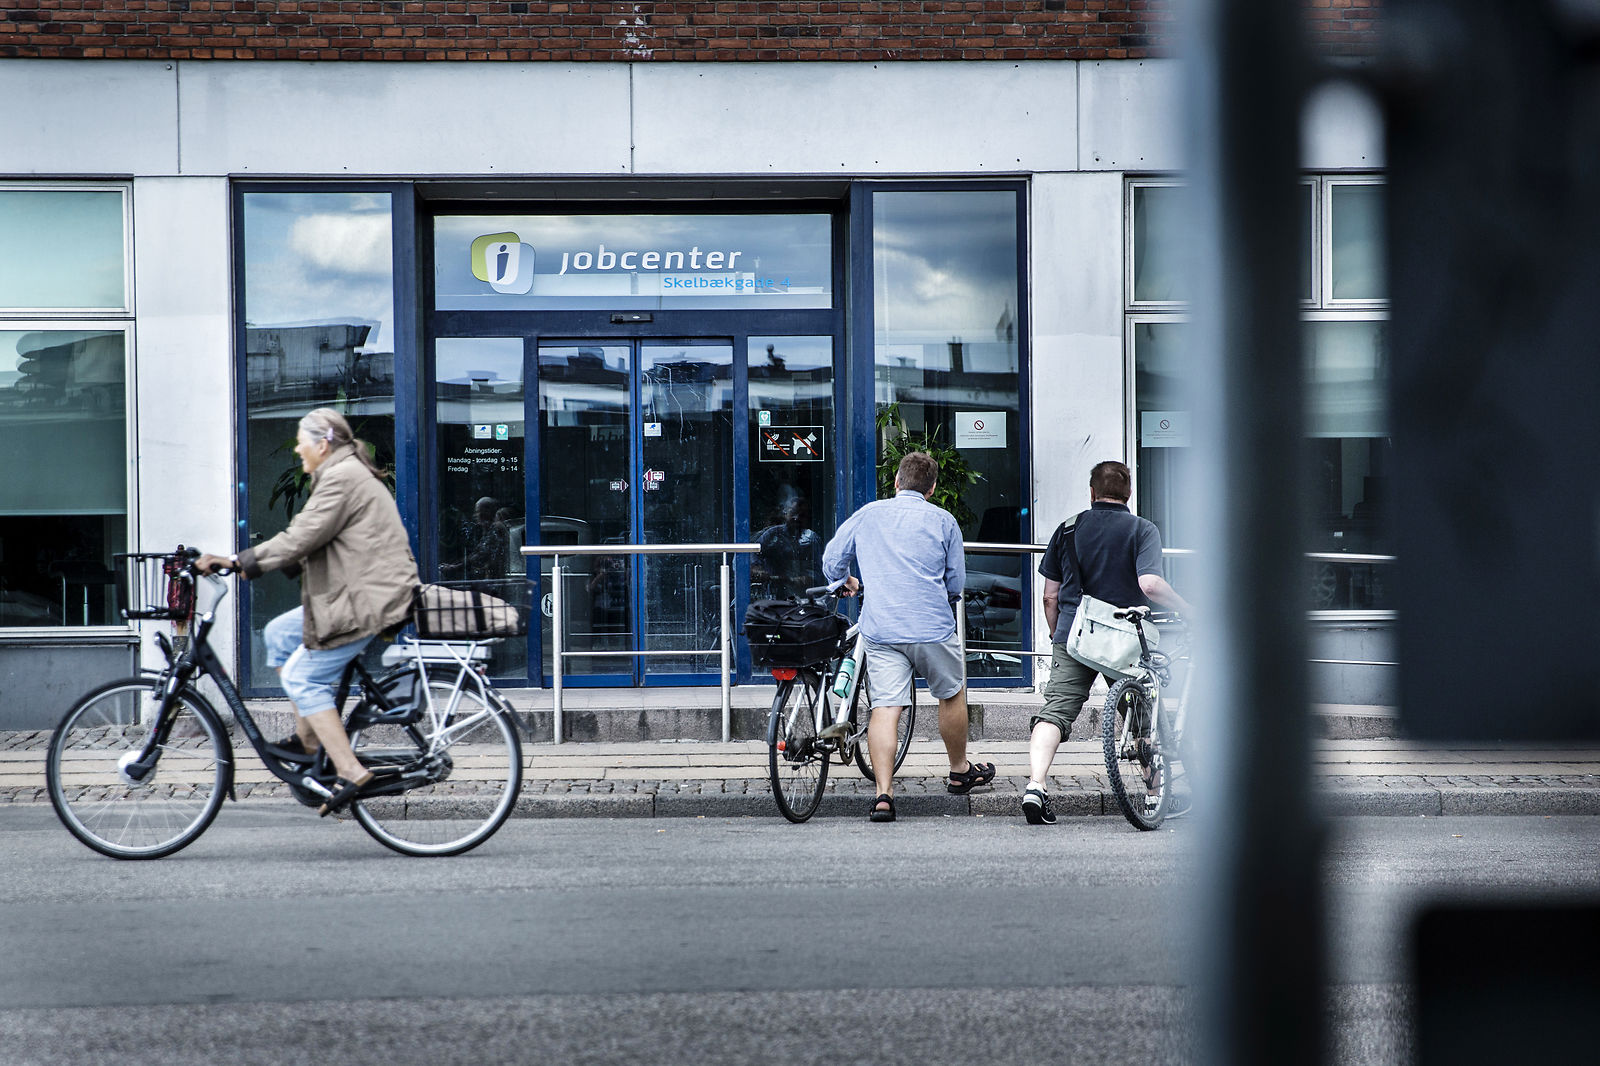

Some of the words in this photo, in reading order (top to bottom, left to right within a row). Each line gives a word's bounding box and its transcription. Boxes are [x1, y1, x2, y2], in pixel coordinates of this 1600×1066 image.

[559, 244, 742, 275] jobcenter
[664, 276, 774, 291] Skelbækgade
[780, 276, 791, 288] 4
[447, 465, 468, 473] Fredag
